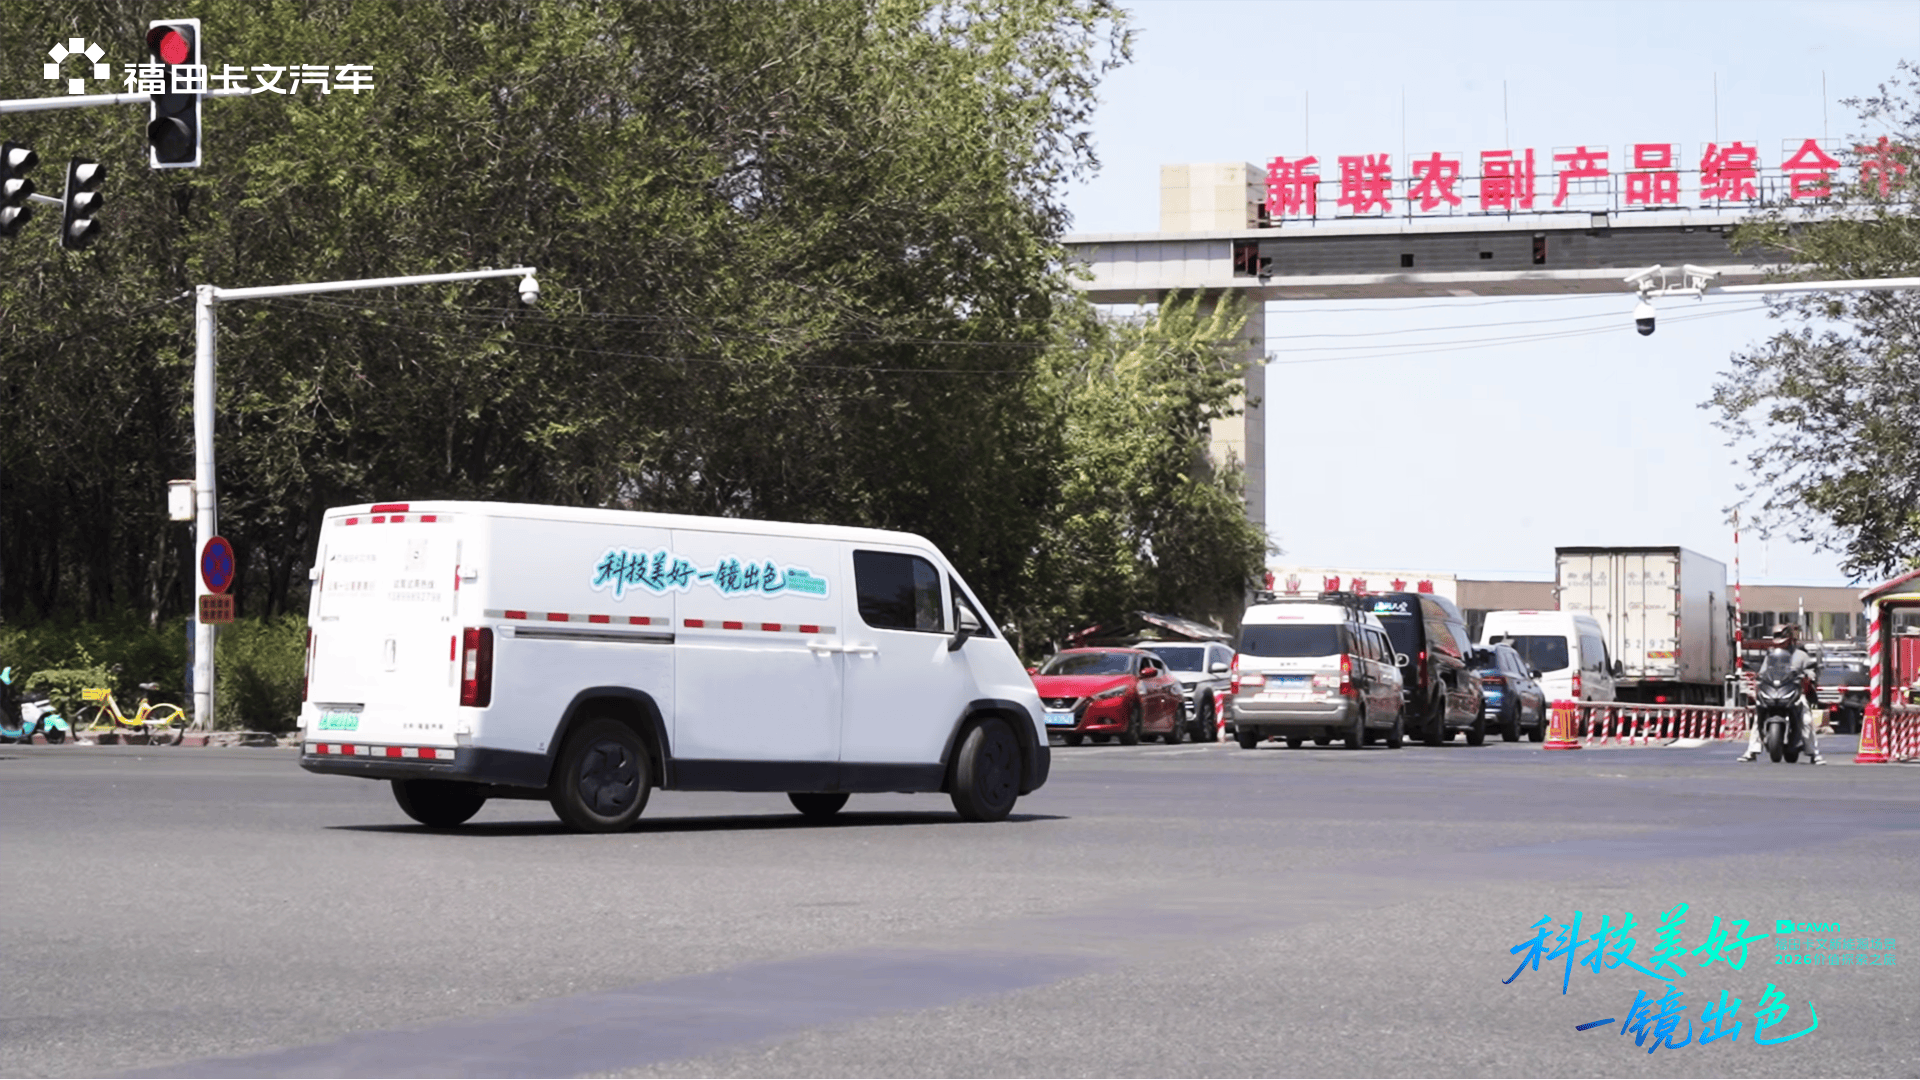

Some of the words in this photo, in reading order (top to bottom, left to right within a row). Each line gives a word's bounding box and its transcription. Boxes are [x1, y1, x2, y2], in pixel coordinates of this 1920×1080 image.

[594, 550, 786, 595] 科技美好一镜出色
